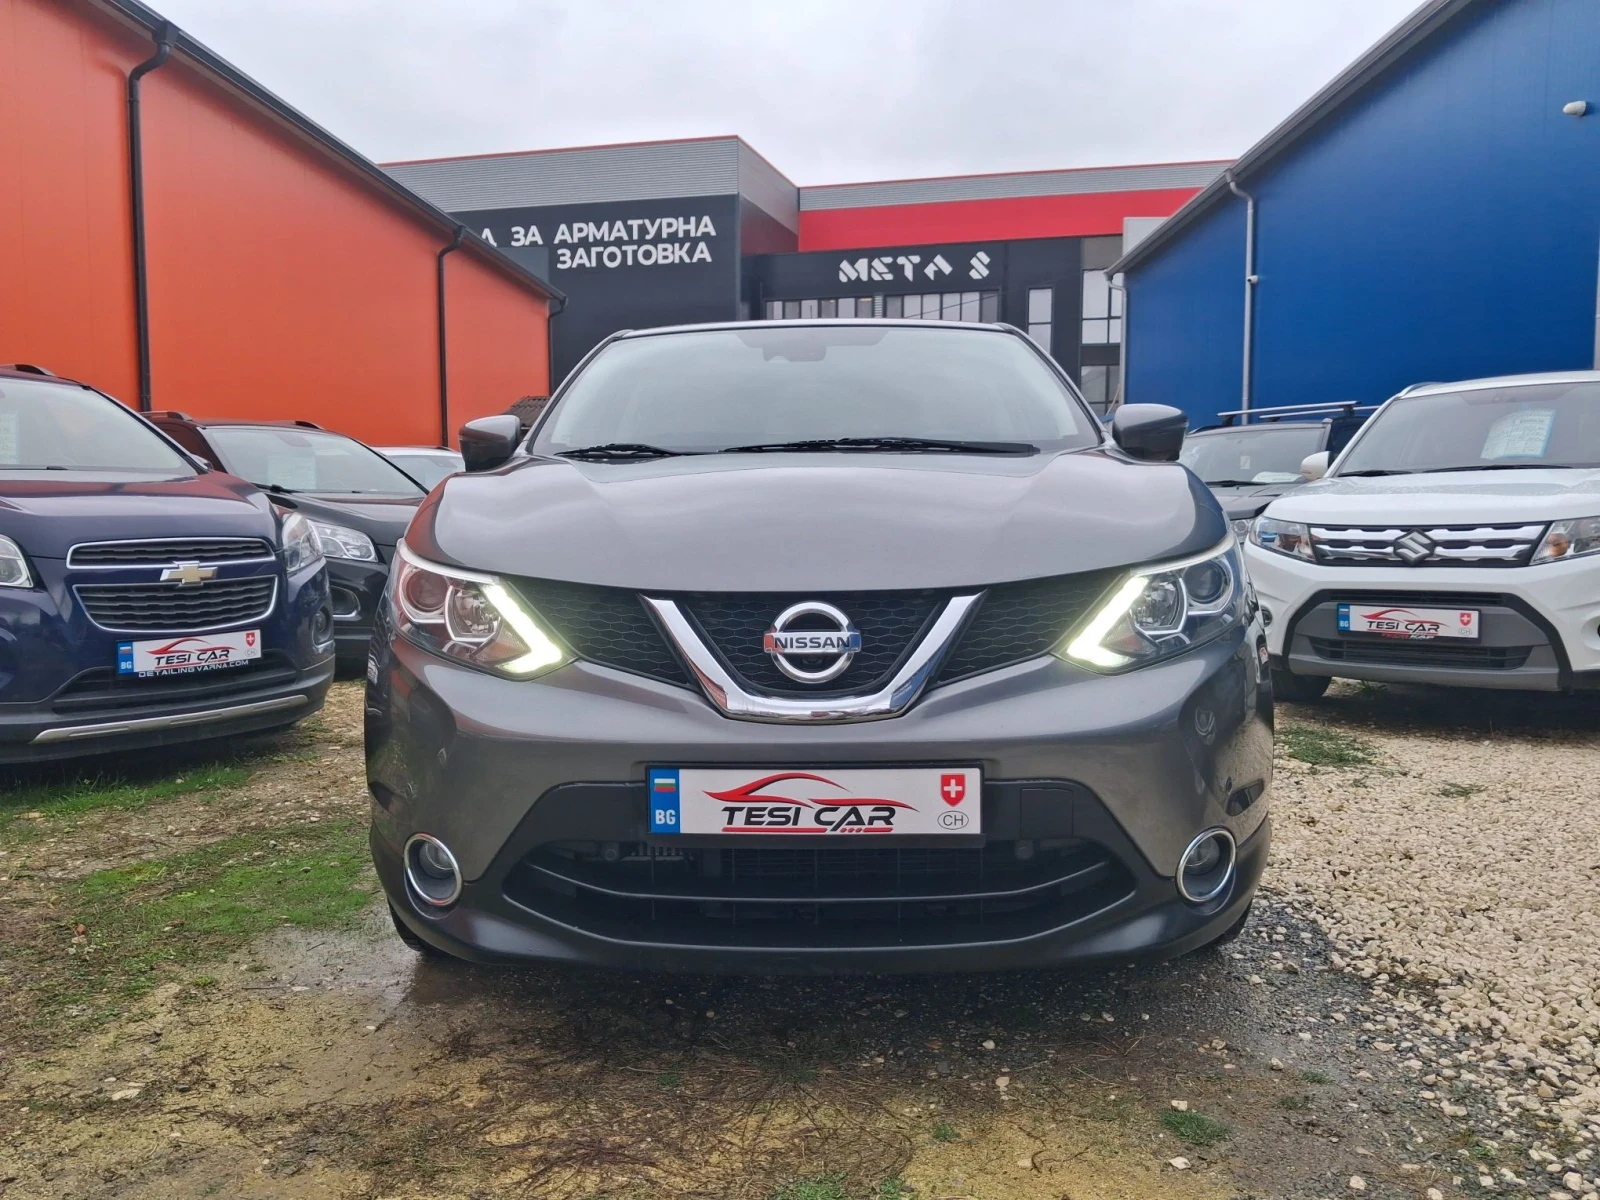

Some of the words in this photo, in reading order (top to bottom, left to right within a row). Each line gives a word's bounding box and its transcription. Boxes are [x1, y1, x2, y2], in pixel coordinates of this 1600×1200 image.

[510, 225, 543, 247] ЗА
[553, 215, 717, 244] АРМАТУРНА
[556, 241, 713, 270] ЗАГОТОВКА
[1367, 620, 1399, 630] TESI
[1404, 622, 1440, 633] CAR
[774, 636, 850, 649] NISSAN
[120, 661, 132, 670] BG
[154, 654, 191, 666] TESI
[196, 649, 230, 663] CAR
[655, 809, 676, 825] BG
[721, 806, 801, 826] TESI
[813, 806, 896, 832] CAR
[942, 813, 964, 827] CH
